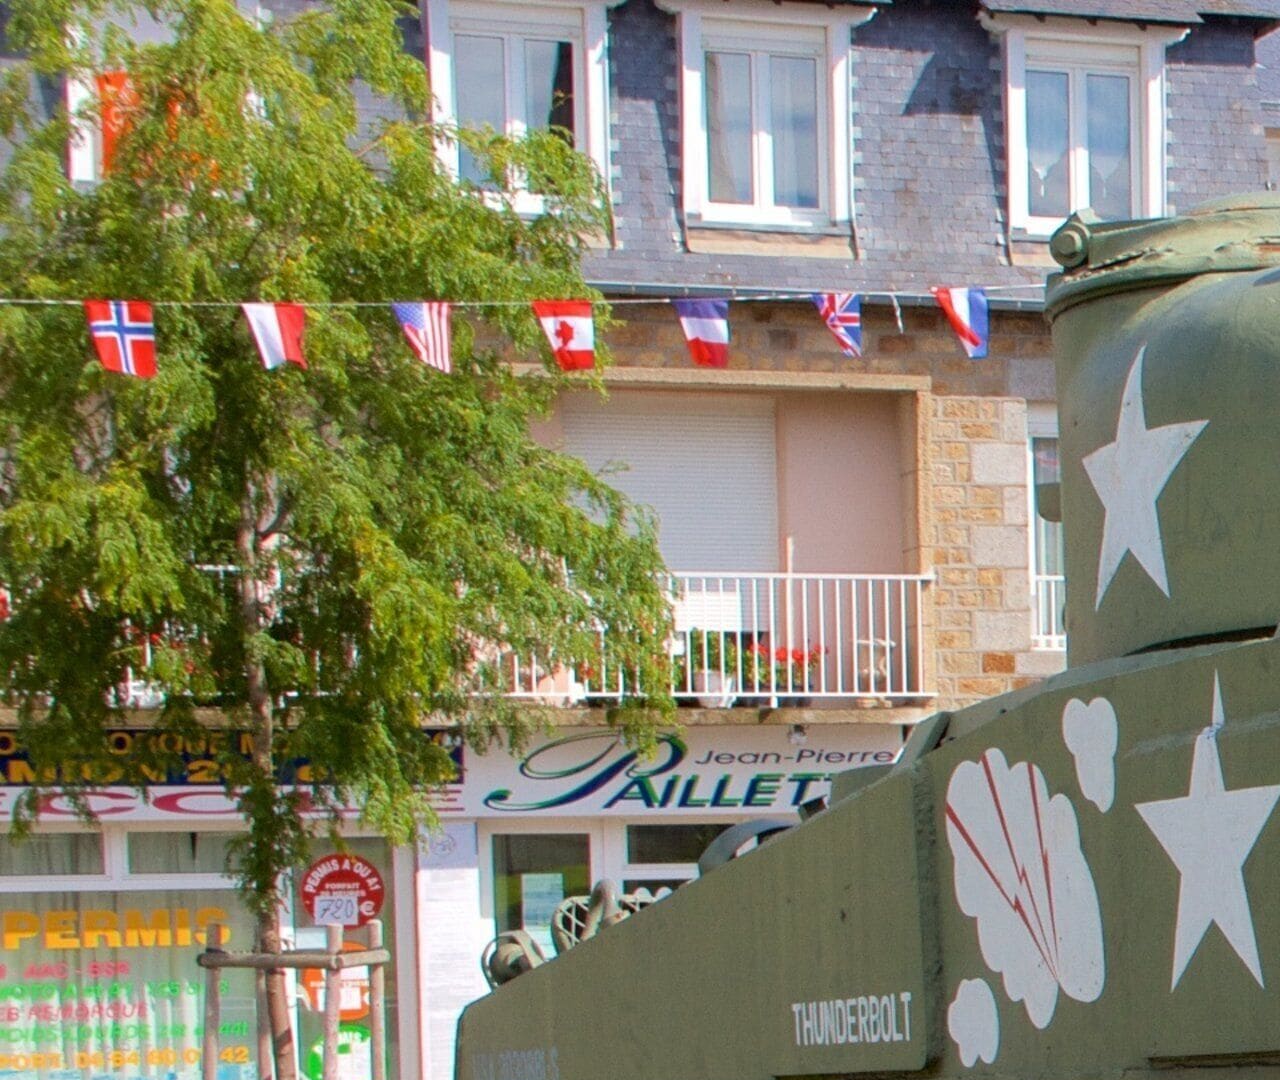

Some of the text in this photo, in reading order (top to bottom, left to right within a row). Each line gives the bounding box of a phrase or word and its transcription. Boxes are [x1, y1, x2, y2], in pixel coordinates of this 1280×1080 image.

[483, 730, 837, 812] PAILLET
[694, 748, 894, 766] Jean-Pierre
[3, 908, 232, 949] PERMIS
[791, 990, 913, 1046] THUNDERBOLT
